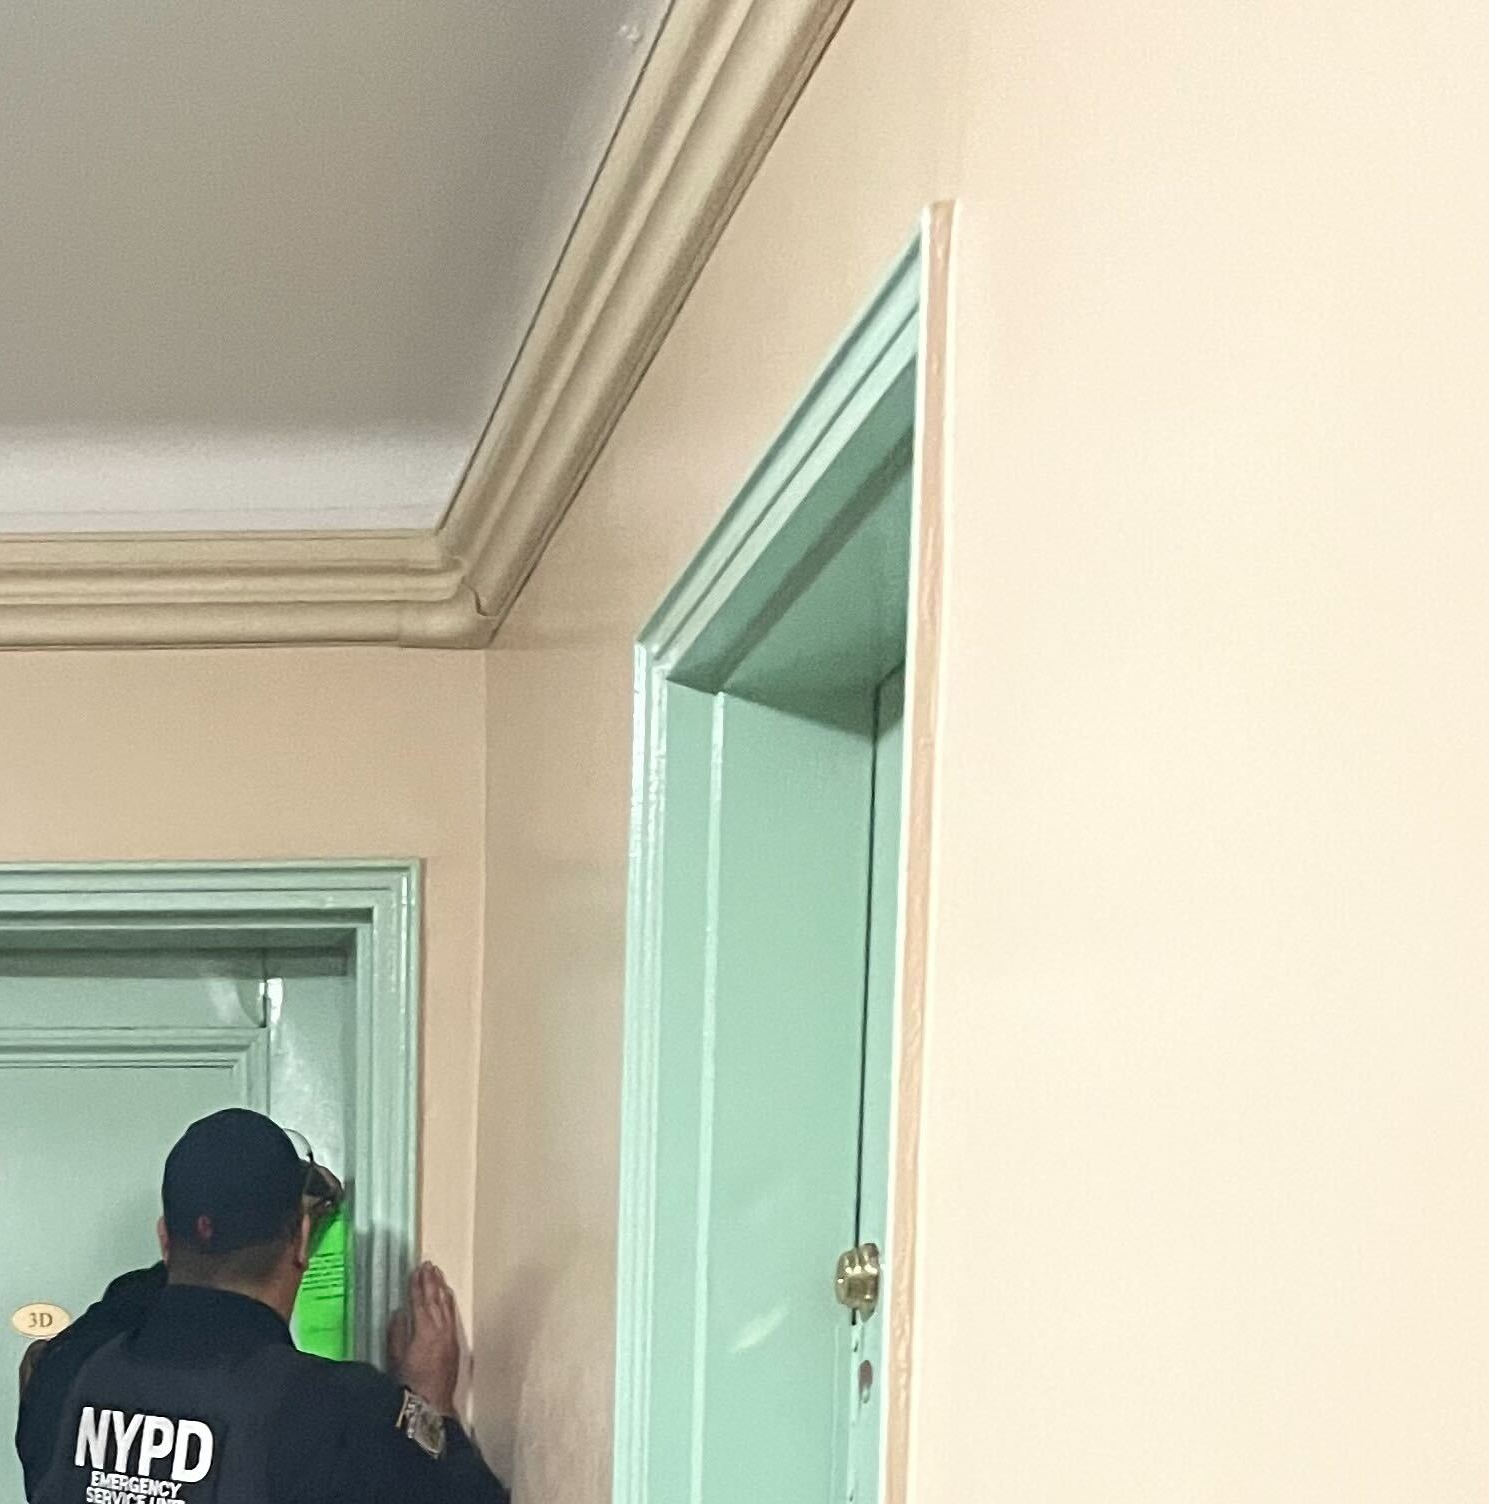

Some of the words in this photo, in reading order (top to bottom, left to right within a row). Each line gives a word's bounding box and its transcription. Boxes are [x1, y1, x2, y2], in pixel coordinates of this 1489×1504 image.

[28, 1312, 53, 1328] 3D
[74, 1406, 214, 1483] NYPD
[91, 1470, 182, 1498] EMERGENCY
